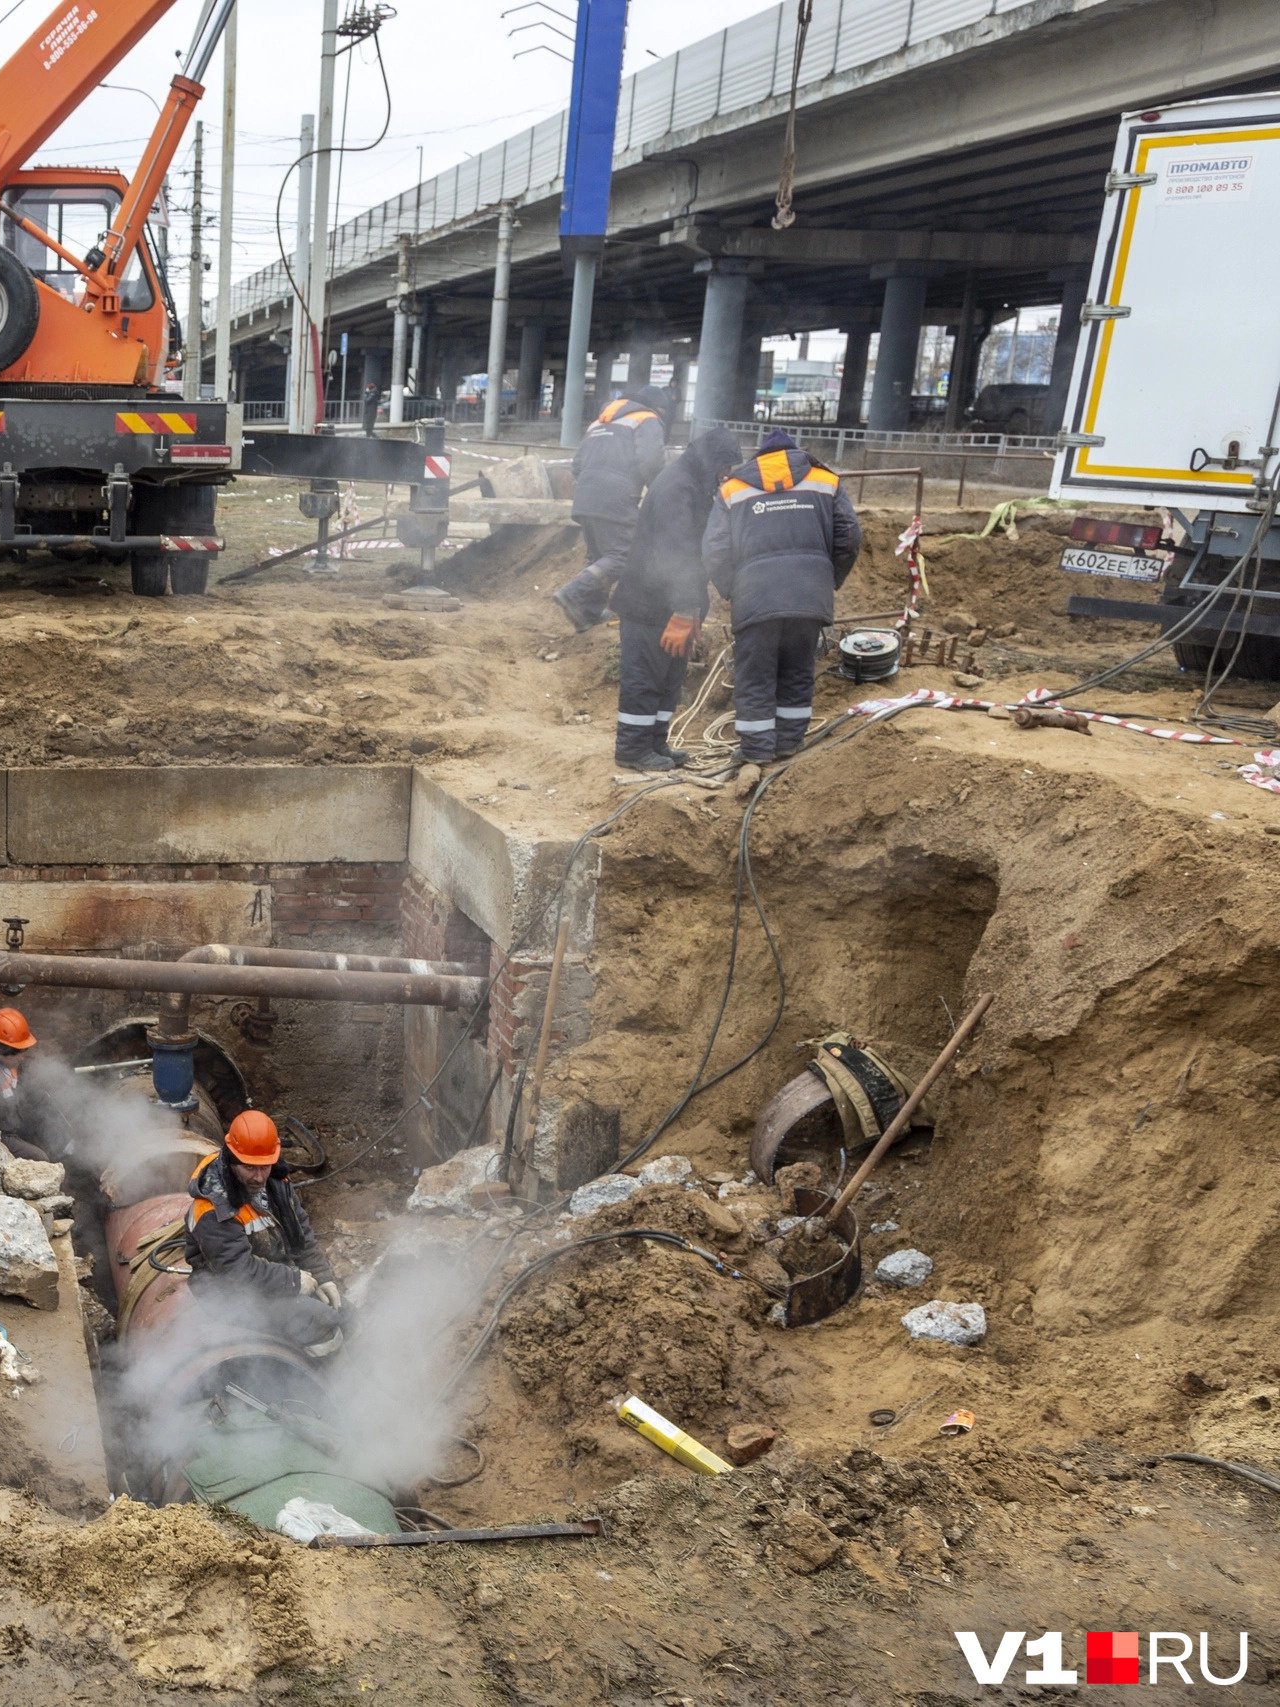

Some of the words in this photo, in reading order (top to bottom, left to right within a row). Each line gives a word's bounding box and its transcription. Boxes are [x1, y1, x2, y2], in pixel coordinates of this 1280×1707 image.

[40, 5, 79, 50] ГОРЯЧАЯ
[50, 16, 79, 51] ЛИНИЯ
[1170, 160, 1248, 174] ПРОМАВТО
[1175, 185, 1194, 194] 800
[1196, 184, 1213, 193] 100
[1215, 183, 1228, 191] 09
[1231, 182, 1243, 191] 35
[1132, 558, 1159, 573] 134
